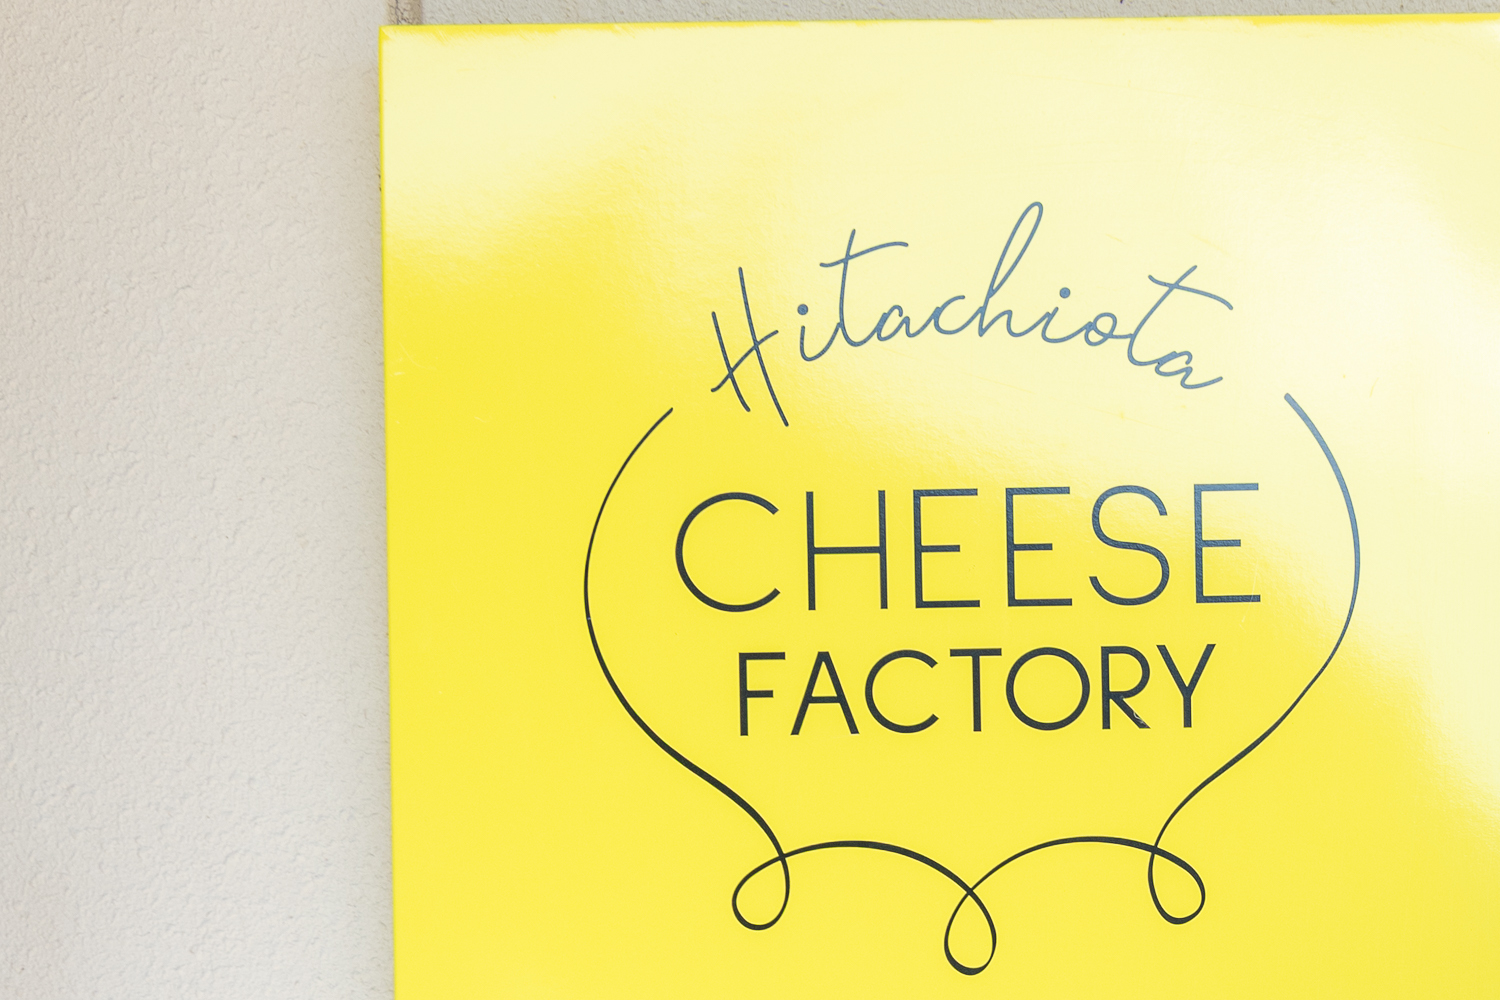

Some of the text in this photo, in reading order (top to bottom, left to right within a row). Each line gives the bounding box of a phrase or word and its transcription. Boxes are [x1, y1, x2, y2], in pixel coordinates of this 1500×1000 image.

[711, 201, 1234, 427] Hitachiota
[675, 482, 1263, 613] CHEESE
[738, 643, 1217, 737] FACTORY
